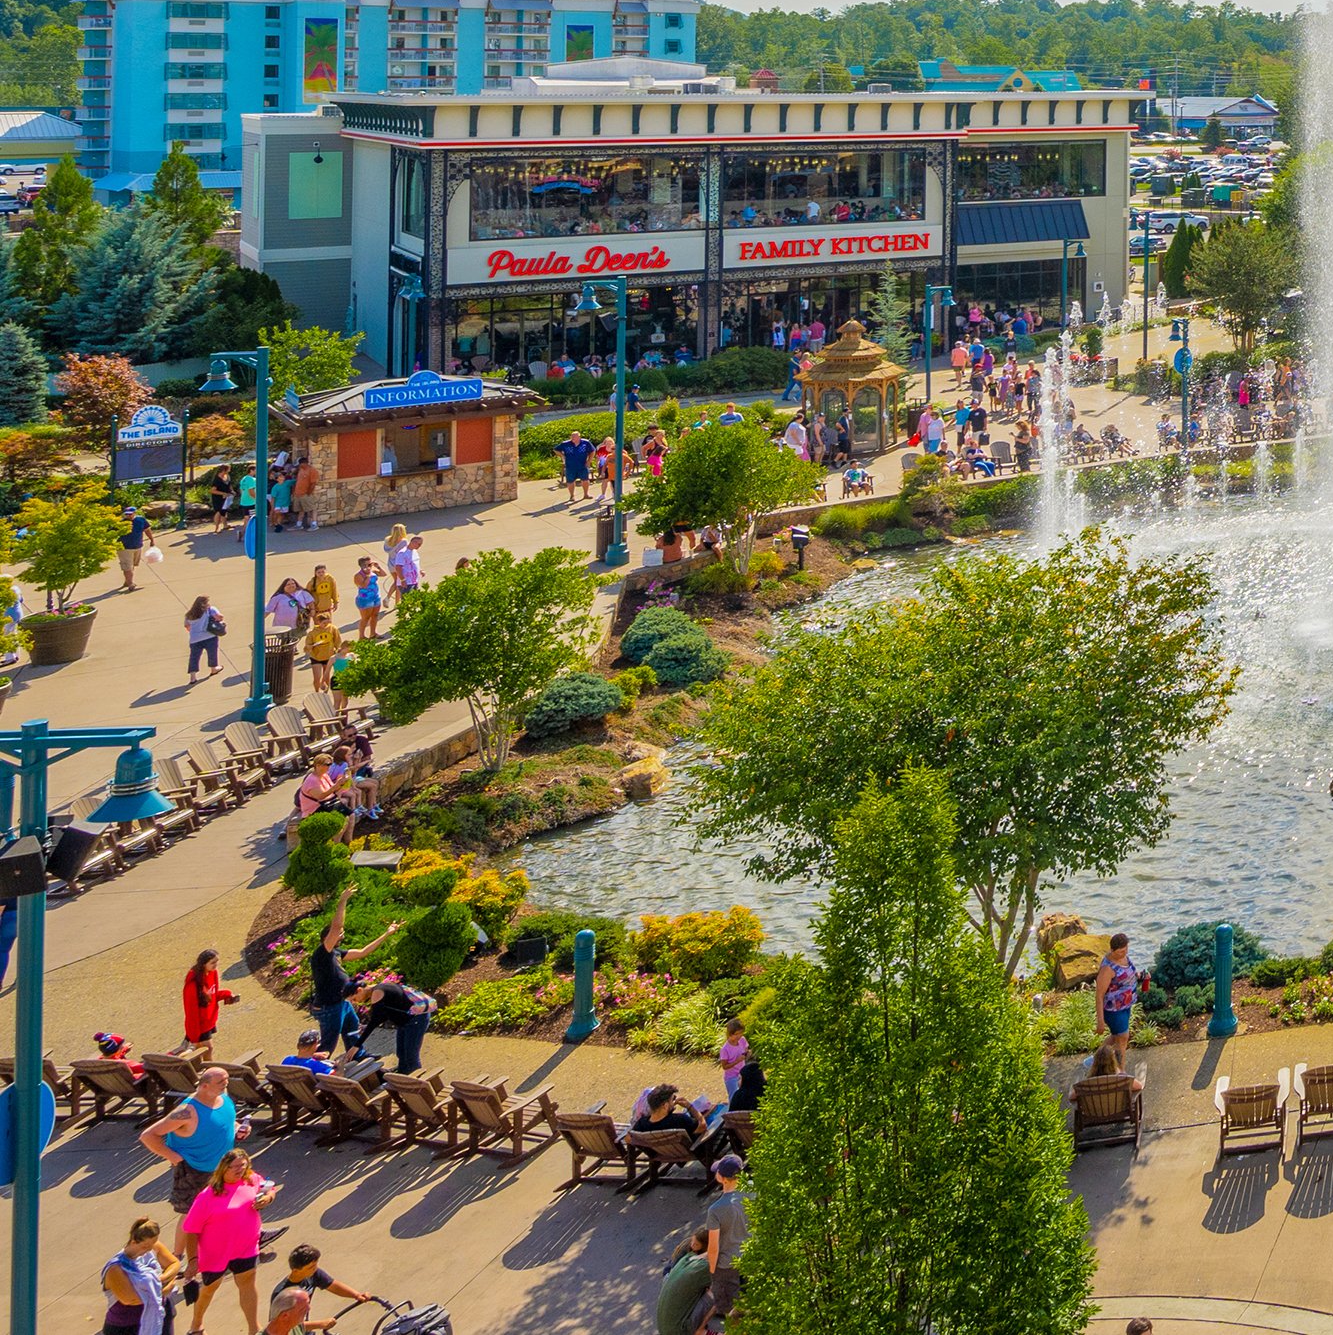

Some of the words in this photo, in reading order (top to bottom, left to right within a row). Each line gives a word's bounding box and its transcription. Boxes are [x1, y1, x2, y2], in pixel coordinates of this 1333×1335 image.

[739, 238, 825, 260] FAMILY
[830, 233, 931, 255] KITCHEN
[487, 249, 574, 278] Paula
[577, 245, 671, 274] Deen's
[370, 384, 479, 404] INFORMATION
[120, 430, 141, 439] THE
[143, 426, 179, 437] ISLAND
[126, 439, 174, 448] DIRECTORY
